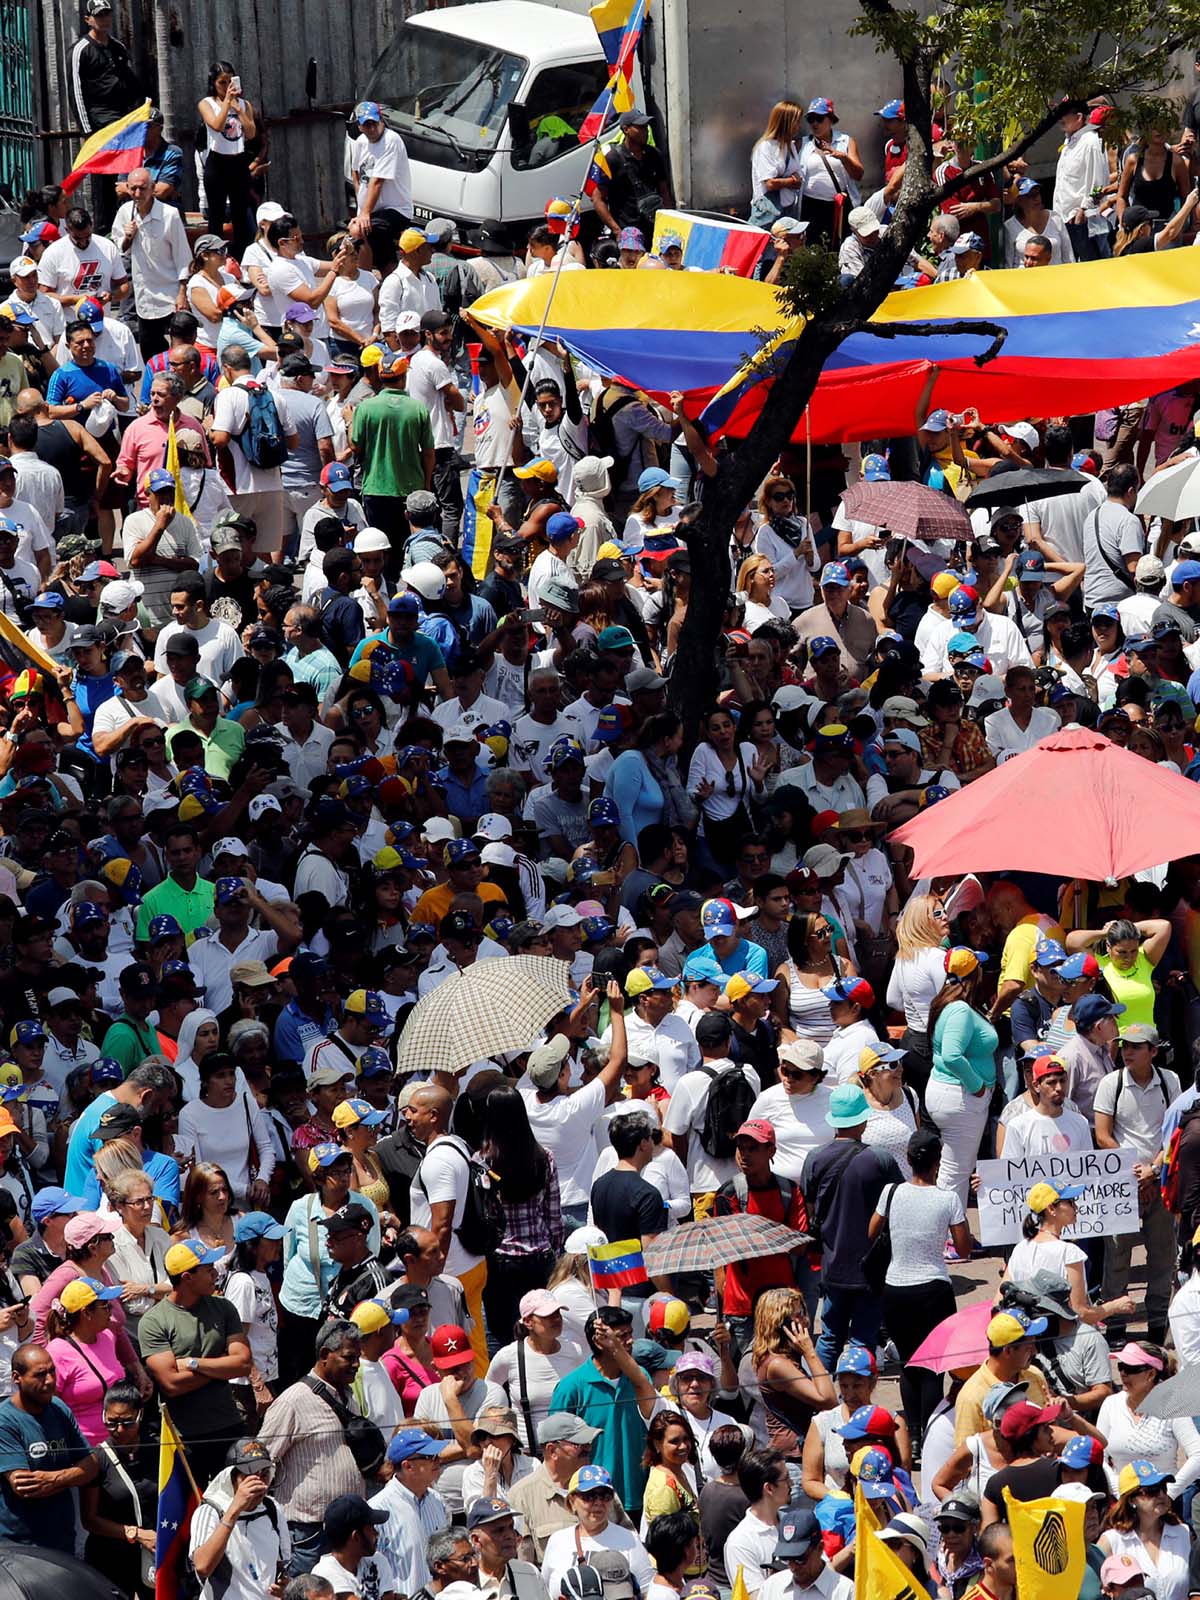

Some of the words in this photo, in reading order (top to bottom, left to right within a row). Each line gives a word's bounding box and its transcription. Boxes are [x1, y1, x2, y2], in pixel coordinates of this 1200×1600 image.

[1007, 1153, 1122, 1182] MADURO
[1082, 1182, 1131, 1201] MADRE
[1114, 1202, 1132, 1216] ES
